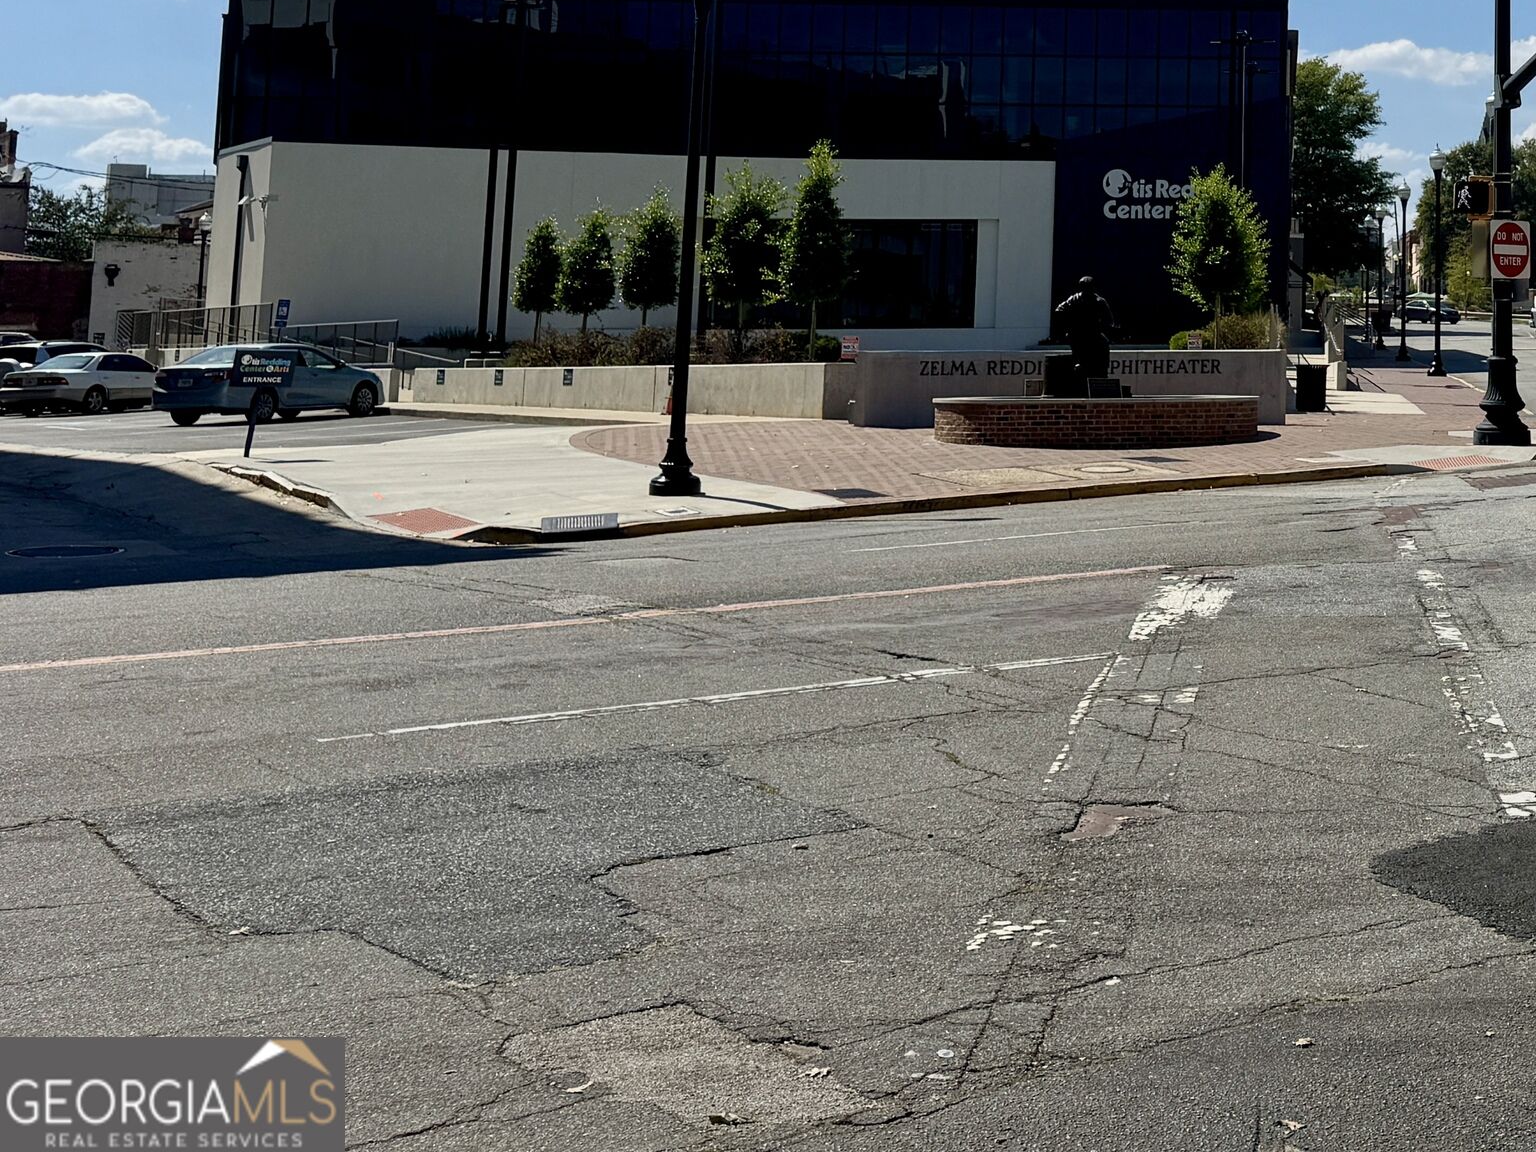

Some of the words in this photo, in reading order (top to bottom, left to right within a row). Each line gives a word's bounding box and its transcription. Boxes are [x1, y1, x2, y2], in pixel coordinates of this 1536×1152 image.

[1103, 200, 1173, 219] Center
[1496, 231, 1507, 241] DO
[1511, 232, 1524, 241] NOT
[1500, 256, 1522, 266] ENTER
[919, 360, 978, 376] ZELMA
[987, 360, 1044, 376] REDDI
[1110, 359, 1222, 375] PHITHEATER
